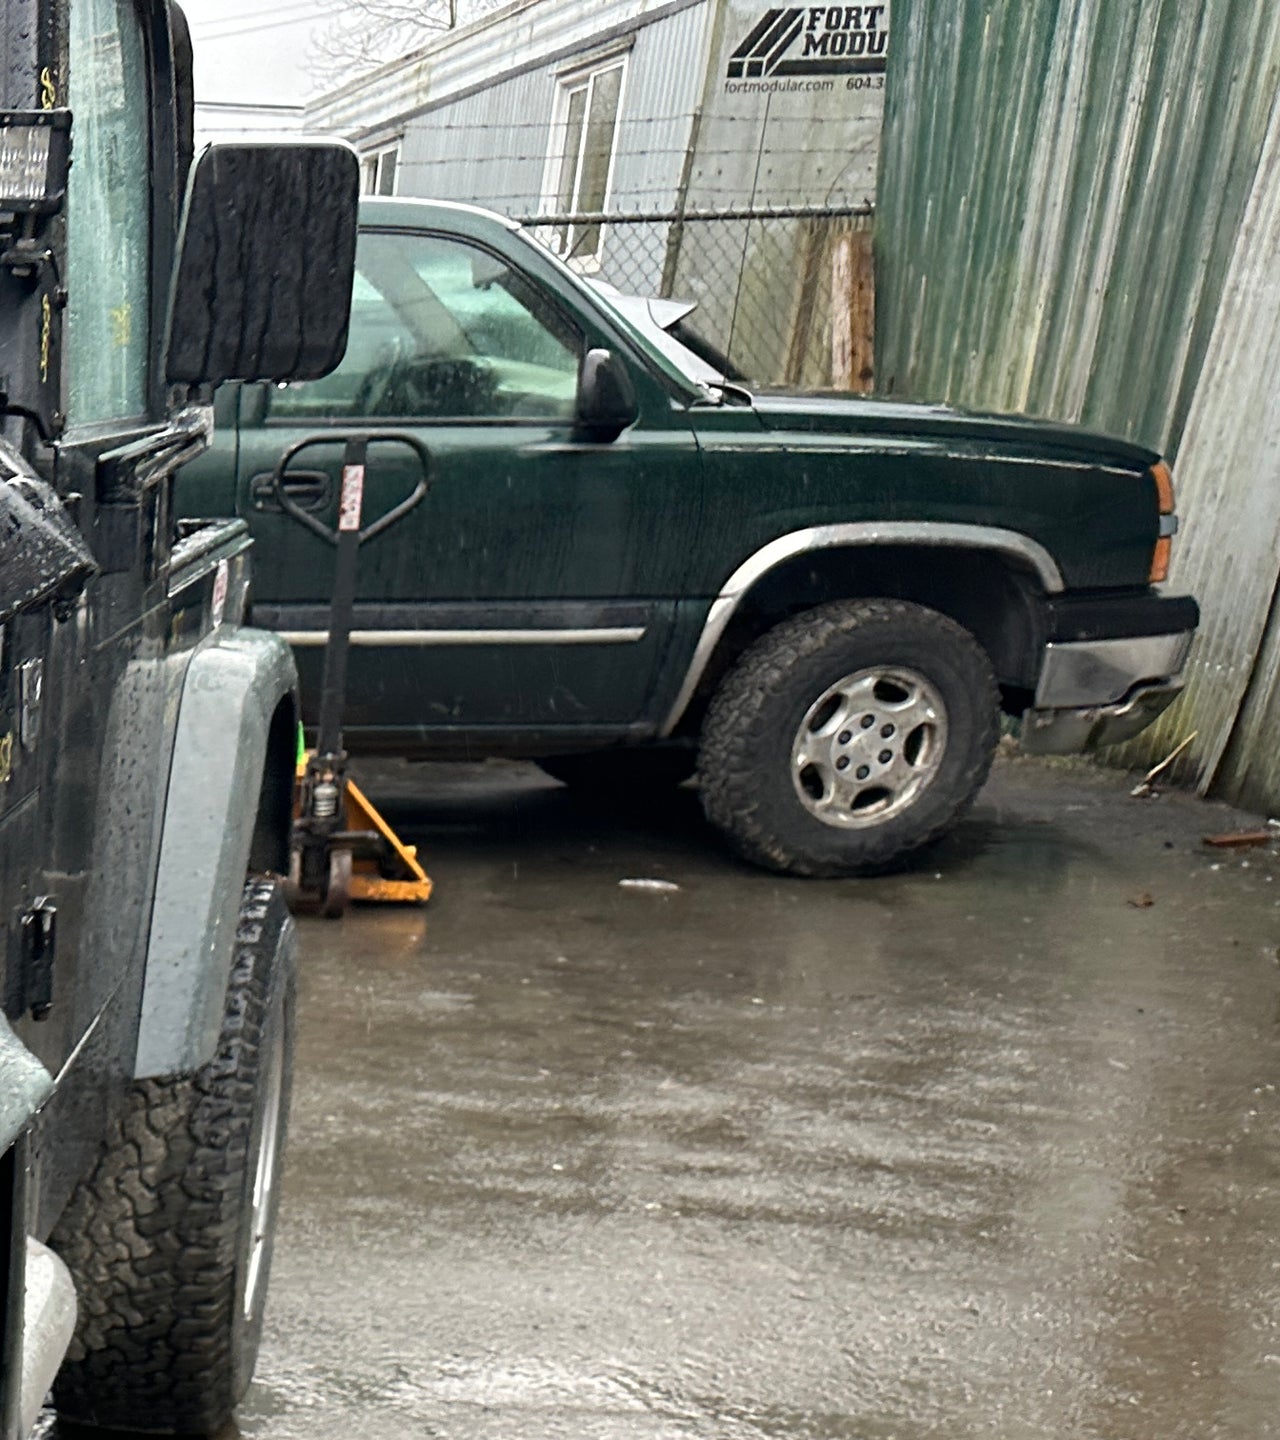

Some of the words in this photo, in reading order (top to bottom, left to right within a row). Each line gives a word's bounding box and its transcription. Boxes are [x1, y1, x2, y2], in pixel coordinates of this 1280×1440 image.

[806, 6, 885, 31] FORT
[802, 31, 889, 56] MODU
[724, 79, 834, 94] fortmodular.com
